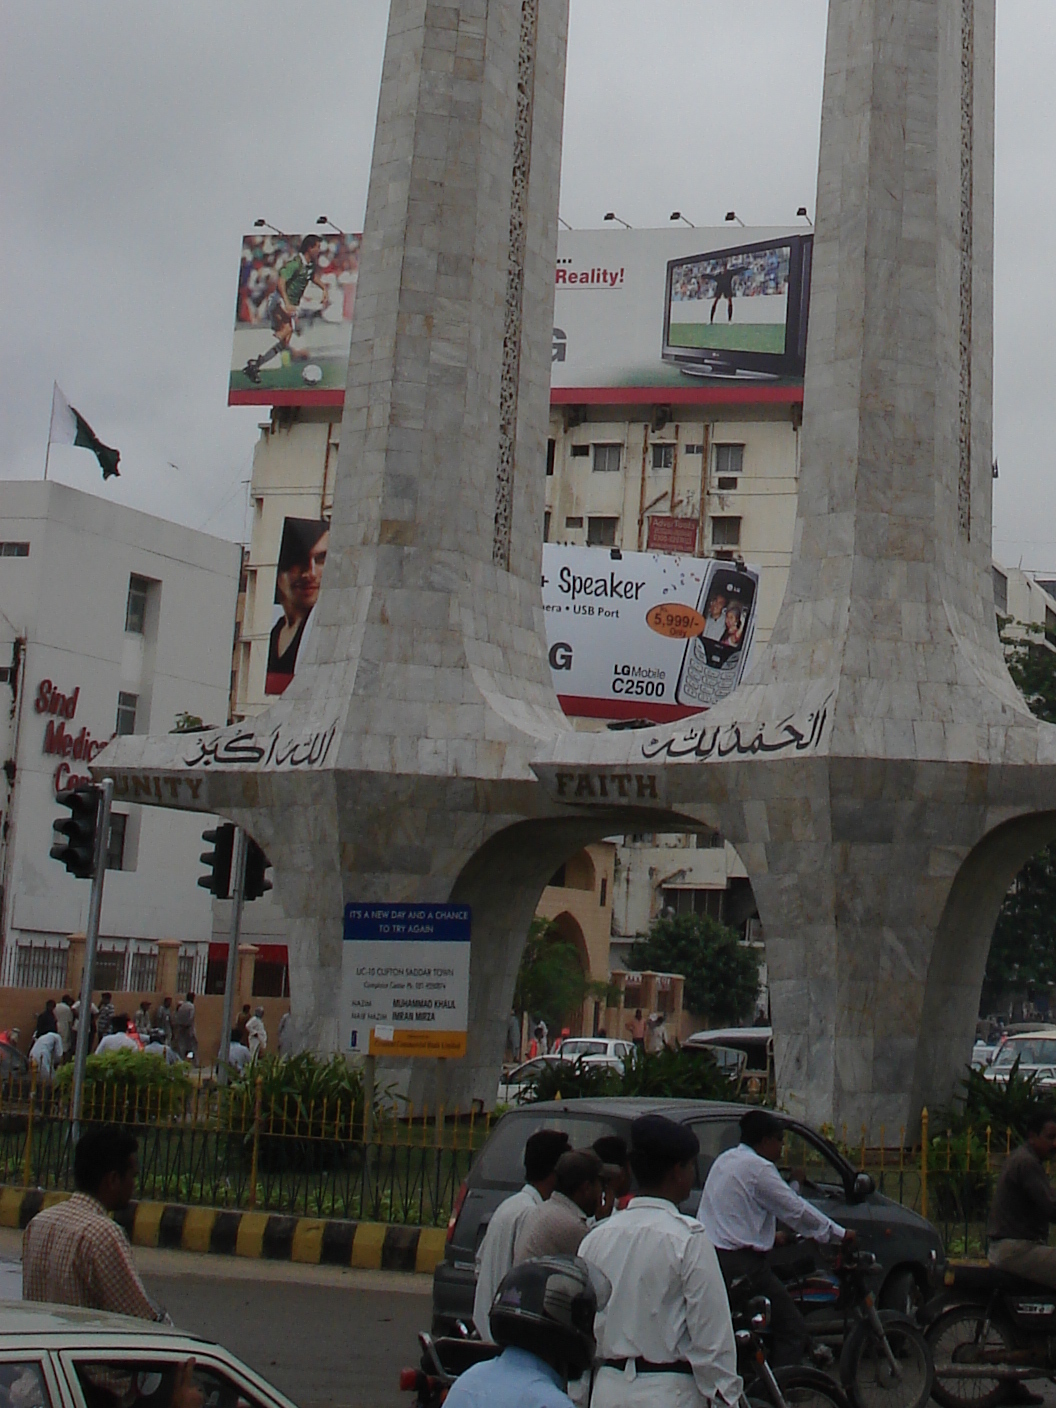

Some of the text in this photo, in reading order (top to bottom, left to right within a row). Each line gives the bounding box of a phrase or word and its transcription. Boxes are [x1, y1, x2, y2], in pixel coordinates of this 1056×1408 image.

[555, 268, 624, 287] Reality!
[558, 566, 646, 600] Speaker
[542, 604, 620, 618] era USB Port
[654, 613, 699, 629] 5,999/-
[669, 628, 687, 638] Only
[612, 678, 665, 697] C2500
[35, 679, 81, 719] Sind
[112, 775, 203, 800] UNITY
[555, 772, 658, 799] FAITH
[364, 910, 370, 919] A
[371, 910, 389, 919] NEW
[391, 911, 406, 920] DAY
[408, 911, 425, 920] AND
[427, 911, 434, 920] A
[435, 911, 468, 920] CHANCE
[379, 924, 434, 933] TO TRY AGAIN
[433, 968, 454, 977] TOWN
[392, 998, 432, 1009] MUHAMMAD
